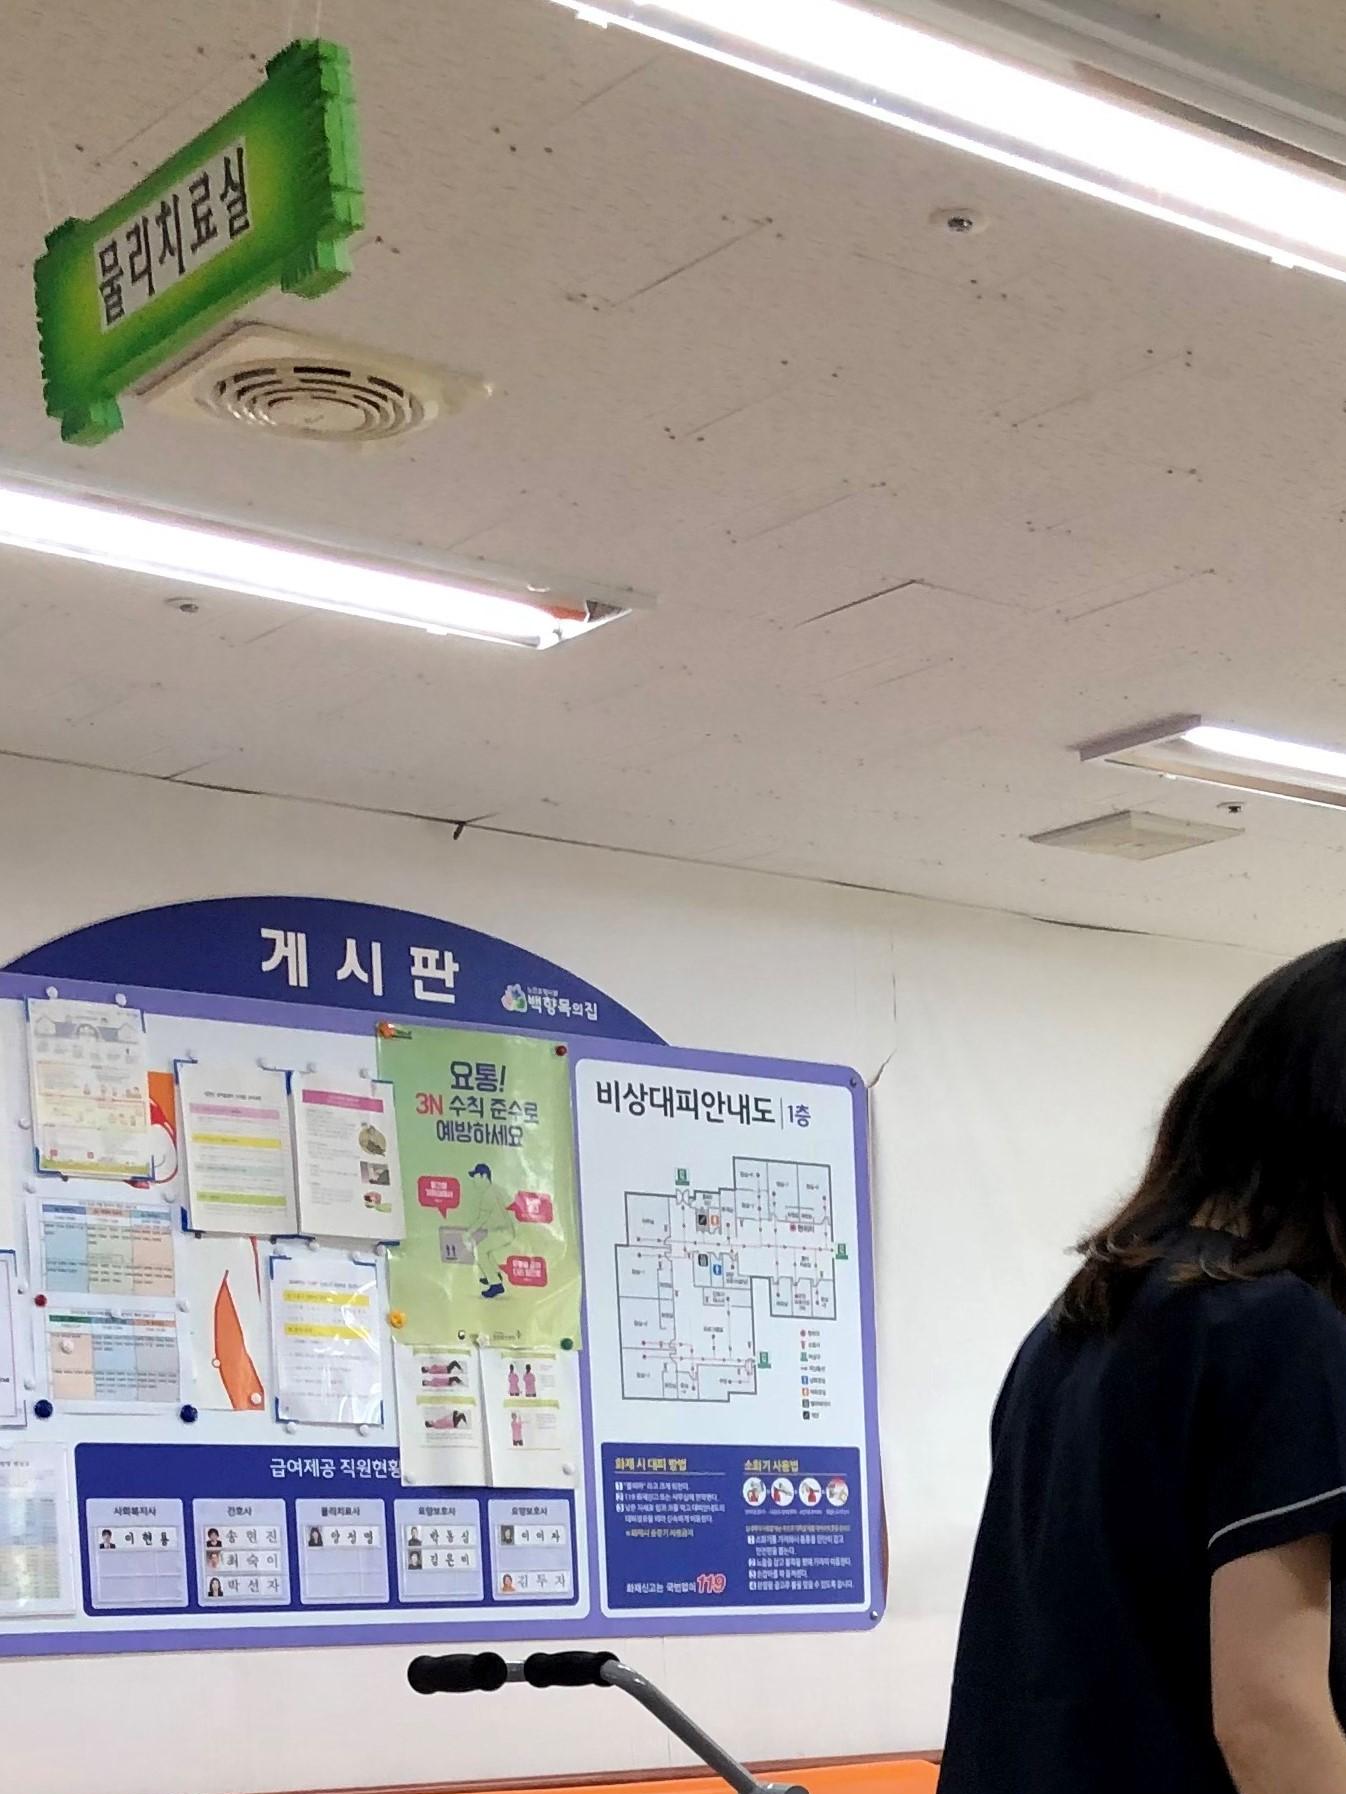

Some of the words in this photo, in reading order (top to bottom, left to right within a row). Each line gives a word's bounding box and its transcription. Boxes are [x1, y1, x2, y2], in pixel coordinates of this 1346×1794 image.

[99, 147, 251, 326] 물리치료실
[528, 995, 597, 1021] 백향목의집
[450, 1061, 506, 1092] 요통!
[416, 1092, 443, 1115] 3N
[449, 1095, 484, 1119] 수칙
[490, 1098, 539, 1124] 준수로
[596, 1080, 775, 1125] 비상대피안내도
[787, 1104, 811, 1127] 1층
[436, 1119, 523, 1147] 예방하세요
[270, 1458, 336, 1479] 급여제공
[744, 1459, 771, 1472] 소화기
[228, 1506, 252, 1517] 간호사
[697, 1573, 726, 1594] 119
